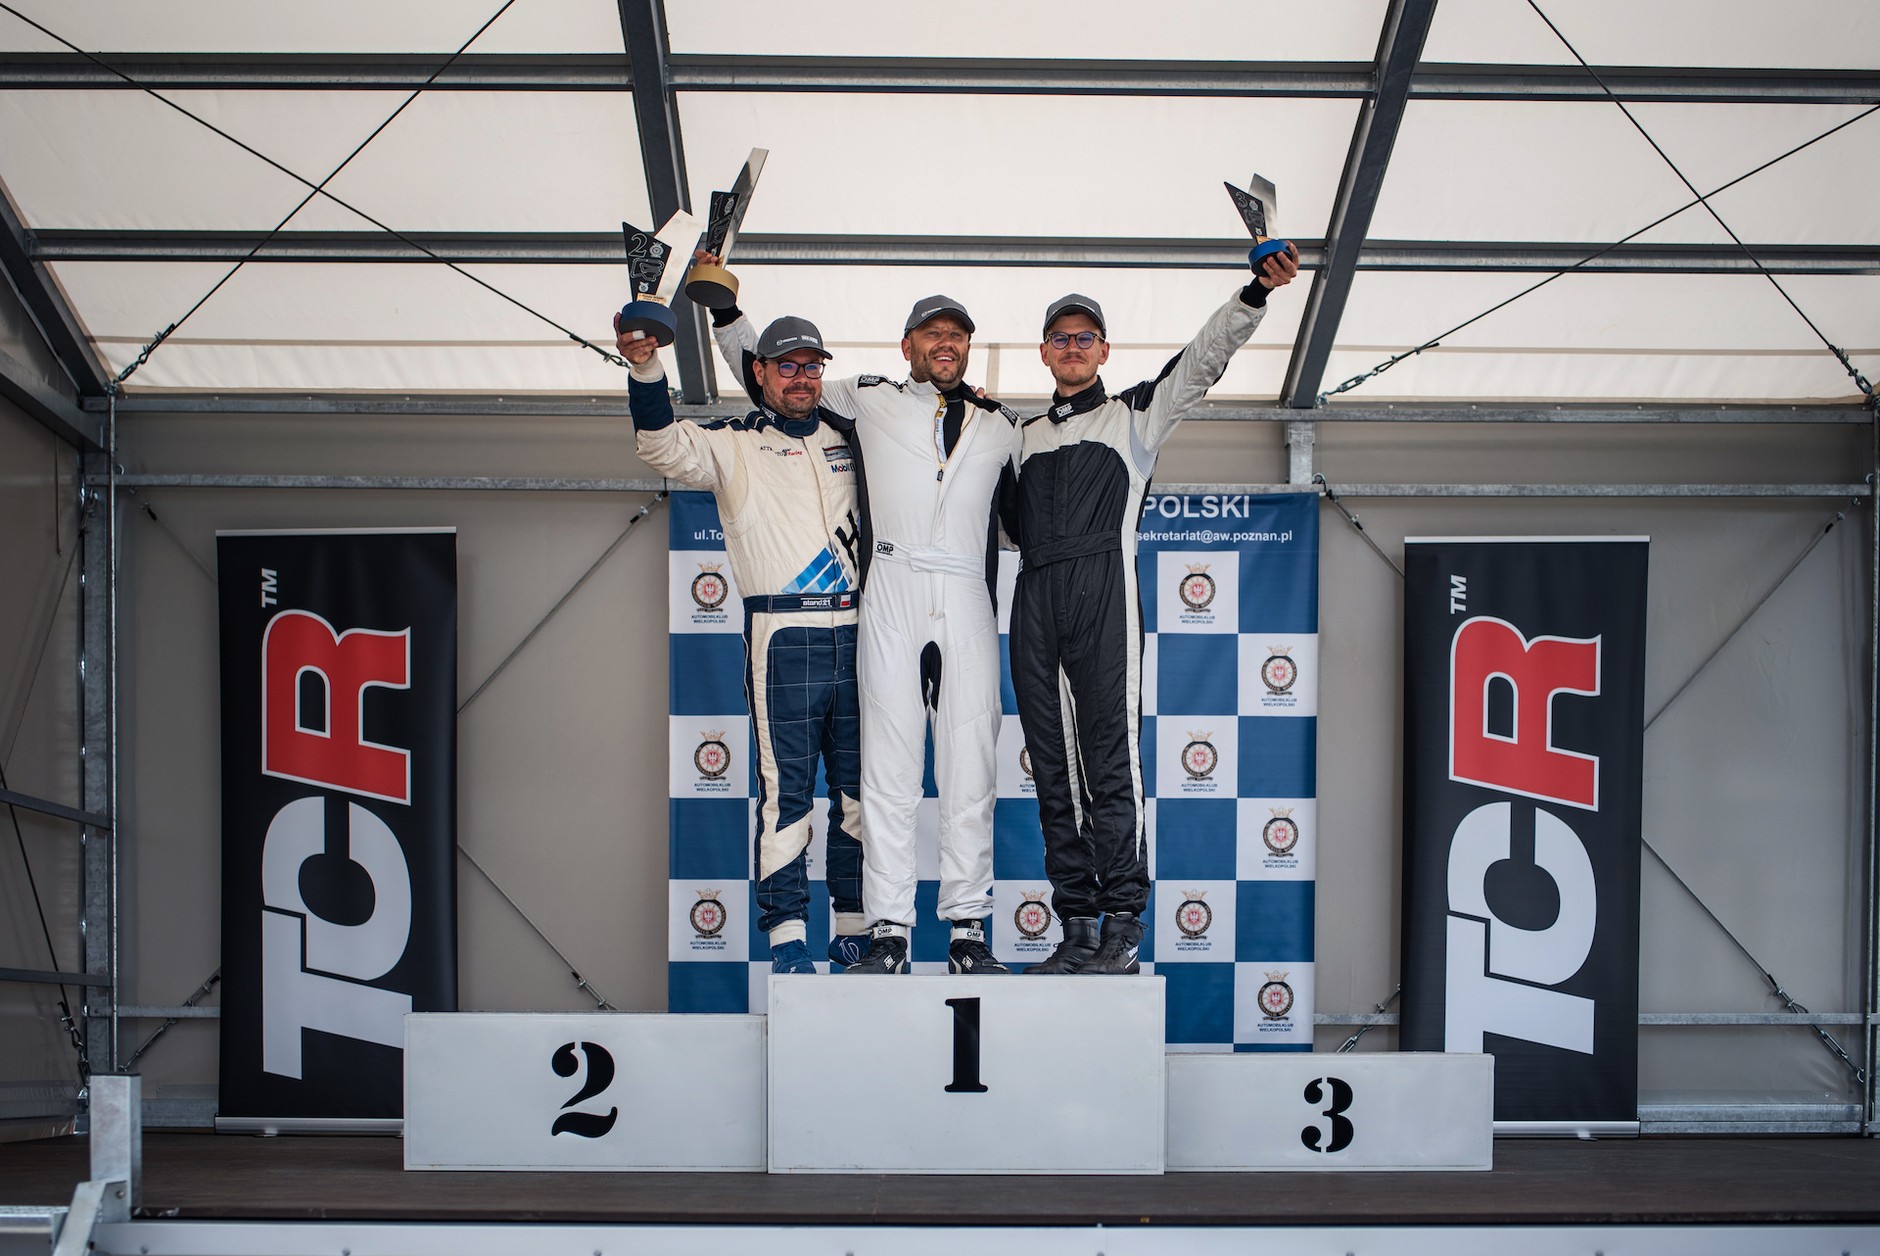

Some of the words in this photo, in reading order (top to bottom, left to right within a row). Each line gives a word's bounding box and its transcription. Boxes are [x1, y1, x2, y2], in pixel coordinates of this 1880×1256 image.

[628, 232, 647, 258] 2
[1142, 495, 1249, 518] POLSKI
[694, 529, 724, 541] ul.To
[876, 543, 894, 554] OMP
[1137, 530, 1293, 544] sekretariat@aw.poznan.pl
[262, 608, 412, 1079] TCR
[1445, 615, 1601, 1054] TCR
[945, 997, 988, 1092] 1
[551, 1042, 617, 1138] 2
[1300, 1076, 1353, 1152] 3
